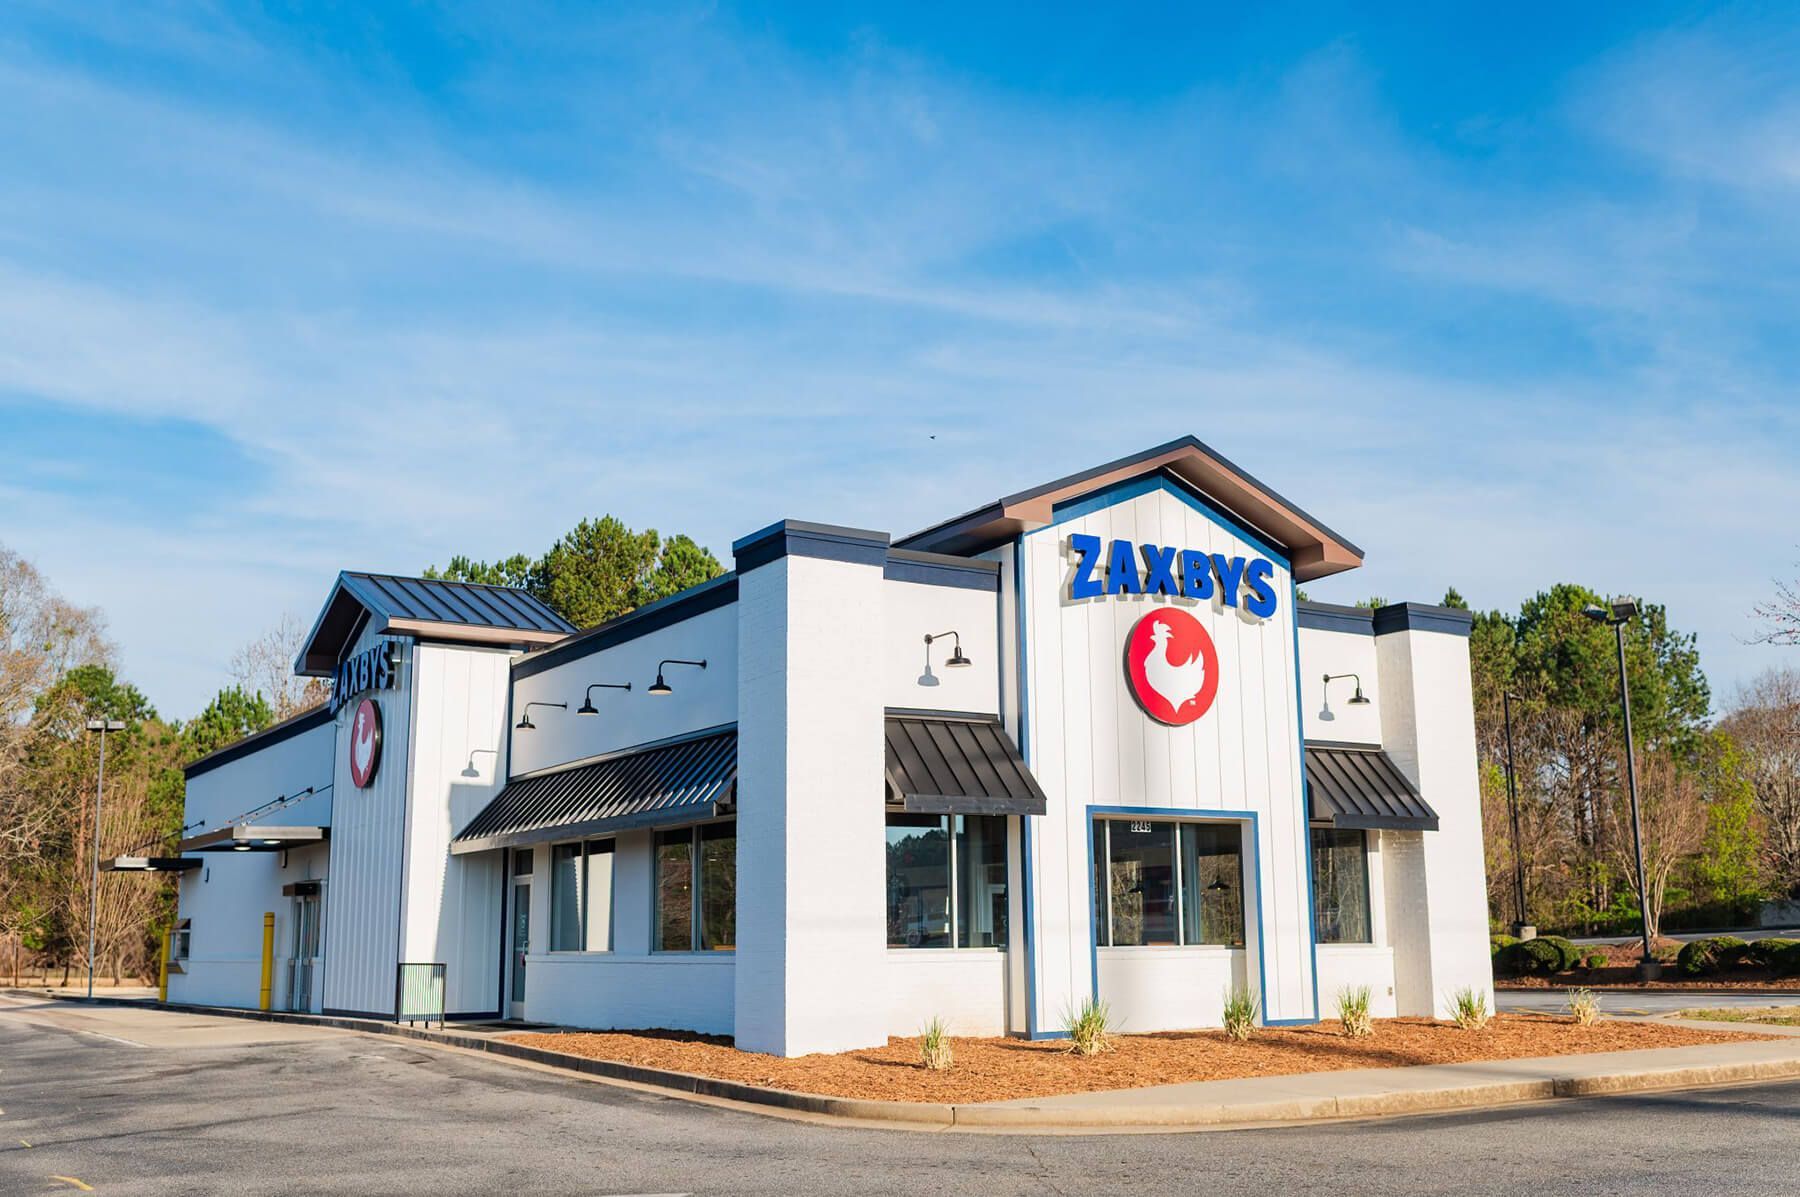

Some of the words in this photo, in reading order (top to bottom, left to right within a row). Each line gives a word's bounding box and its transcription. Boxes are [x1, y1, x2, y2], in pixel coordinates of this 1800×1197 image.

[1070, 533, 1278, 619] ZAXBYS
[329, 640, 389, 714] ZAXBYS
[1131, 820, 1151, 832] 2245
